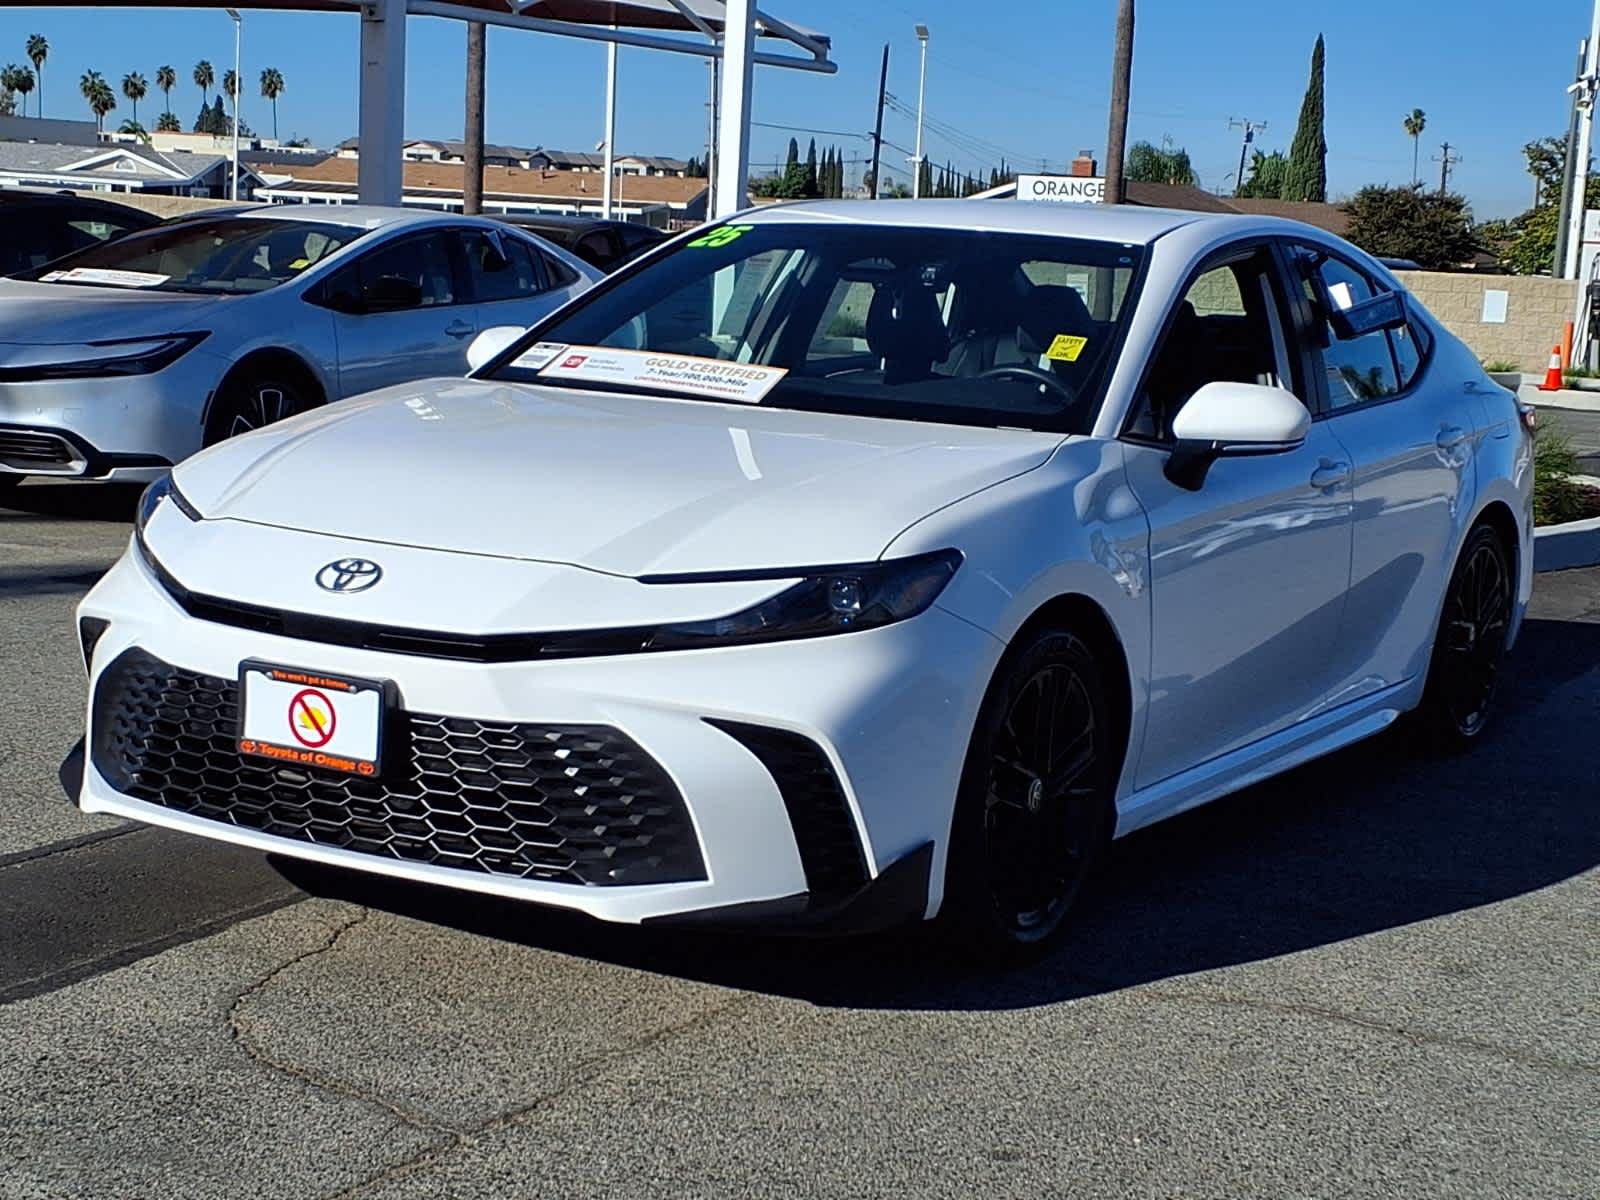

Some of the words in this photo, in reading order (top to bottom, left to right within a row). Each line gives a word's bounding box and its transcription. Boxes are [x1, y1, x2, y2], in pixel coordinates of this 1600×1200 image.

[1033, 180, 1105, 197] ORANGE
[686, 225, 755, 247] 25
[1057, 336, 1084, 345] SAFETY
[645, 358, 689, 370] GOLD
[690, 362, 769, 381] CERTIFIED
[258, 743, 298, 760] Toyota
[301, 752, 313, 762] of
[315, 753, 356, 771] Orange
